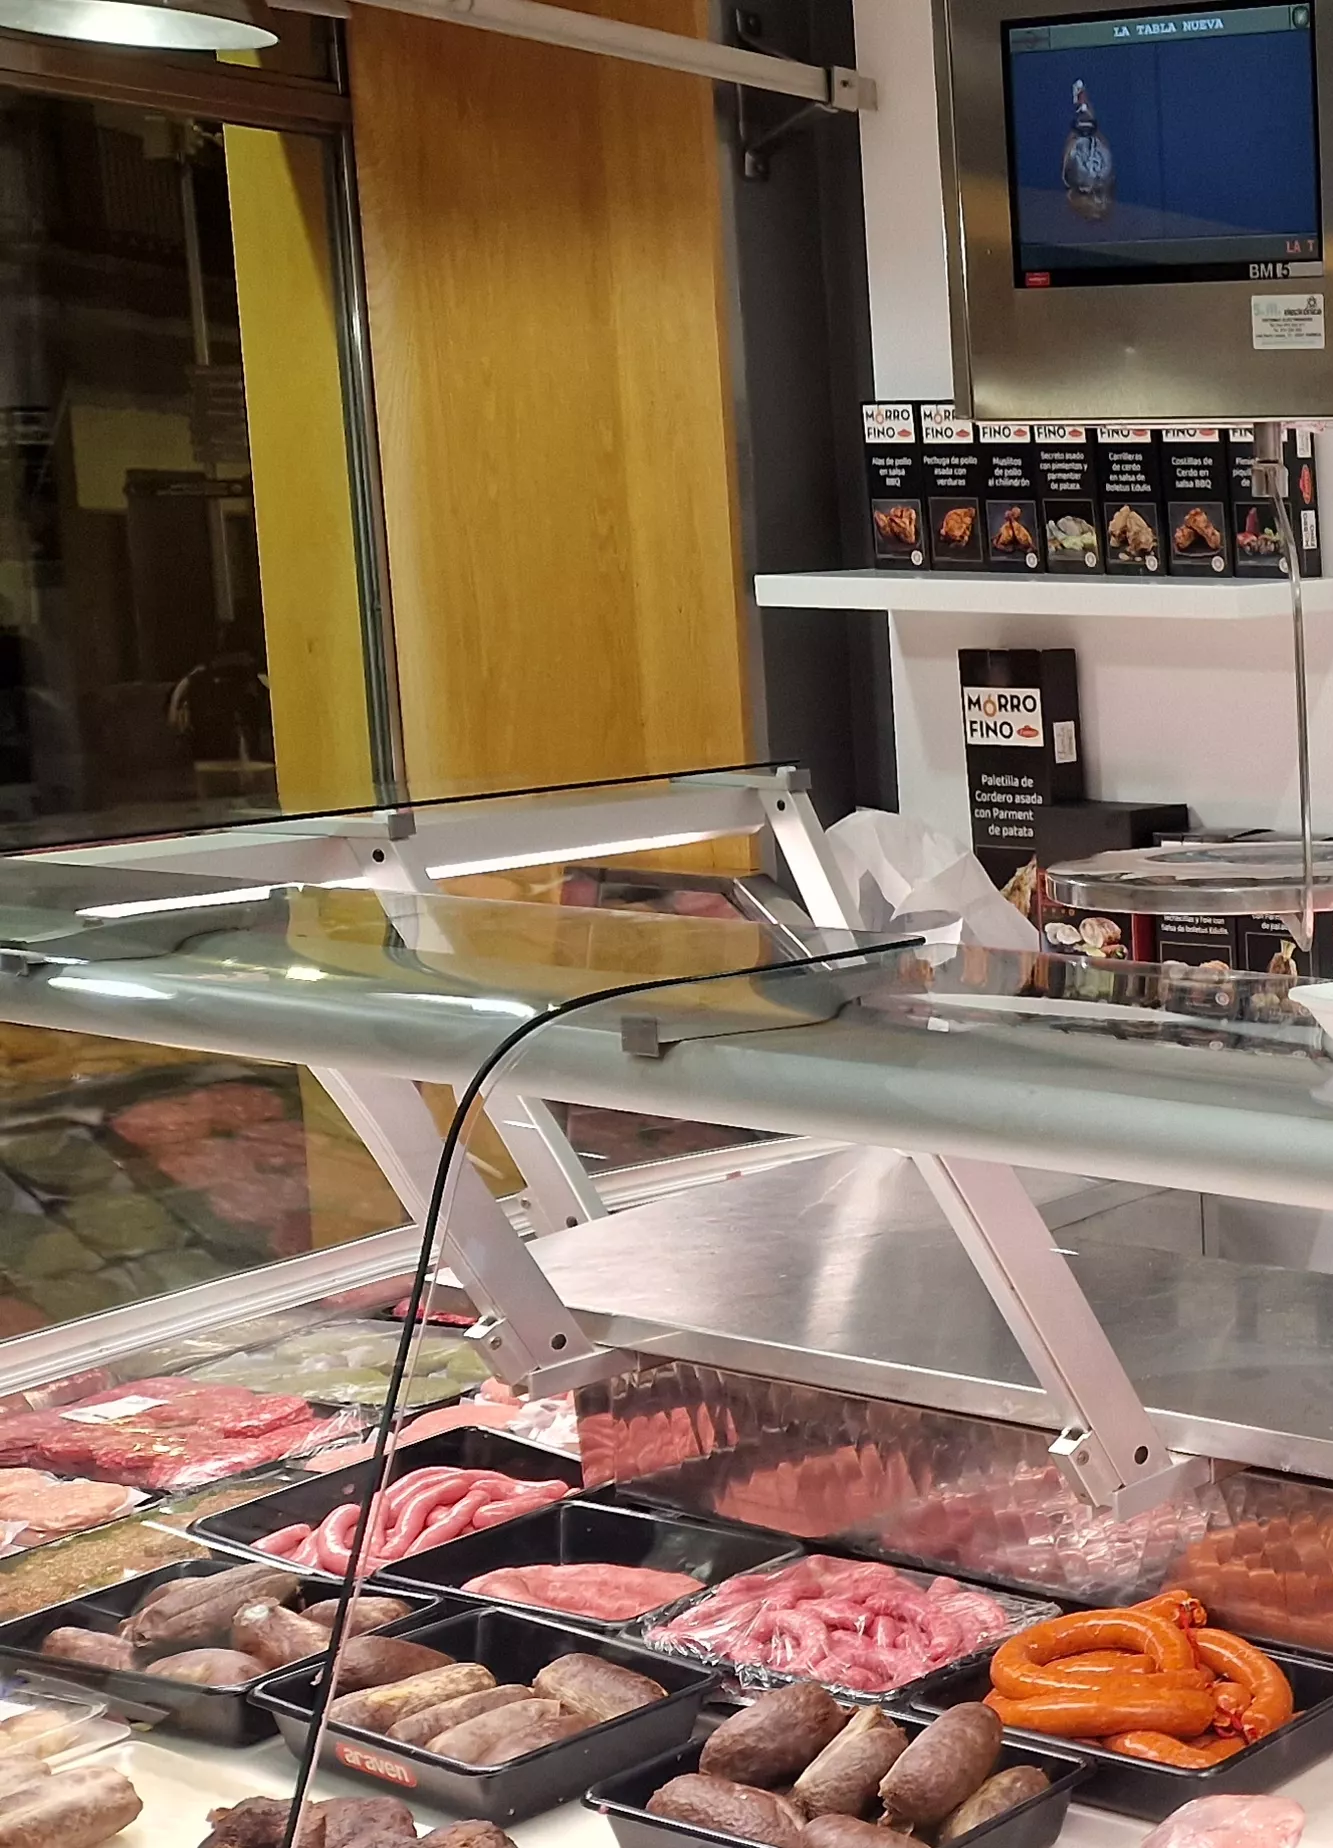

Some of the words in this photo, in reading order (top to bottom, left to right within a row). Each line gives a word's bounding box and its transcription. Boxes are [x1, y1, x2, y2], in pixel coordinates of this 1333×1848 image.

[1114, 26, 1129, 37] LA
[1136, 23, 1176, 35] TABLA
[1183, 18, 1224, 32] NUEVA
[1286, 240, 1301, 253] LA
[1307, 240, 1314, 252] T
[866, 408, 910, 425] MORRO
[923, 409, 956, 424] MOR
[867, 426, 895, 439] FINO
[925, 426, 954, 439] FINO
[982, 426, 1011, 439] FINO
[1037, 426, 1066, 439] FINO
[1232, 429, 1253, 438] FIN
[886, 456, 894, 466] de
[895, 456, 912, 467] pollo
[923, 456, 949, 467] Pechuga
[950, 456, 958, 465] de
[960, 456, 977, 466] pollo
[993, 457, 1022, 467] Muslitos
[1112, 463, 1120, 471] de
[1171, 457, 1202, 466] Costillas
[1203, 457, 1213, 466] de
[889, 467, 905, 476] salsa
[954, 468, 966, 476] con
[994, 468, 1004, 477] de
[1004, 468, 1022, 478] pollo
[1176, 469, 1198, 477] Cerdo
[1199, 469, 1209, 477] en
[936, 477, 966, 487] verduras
[1119, 473, 1136, 481] salsa
[1136, 474, 1145, 482] de
[1050, 482, 1058, 490] de
[1176, 479, 1194, 488] salsa
[967, 693, 1037, 717] MORRO
[969, 720, 1014, 739] FINO
[981, 774, 1019, 788] Paletilla
[1021, 775, 1034, 788] de
[975, 790, 1013, 804] Cordero
[1015, 793, 1043, 804] asada
[974, 808, 991, 818] con
[988, 824, 1000, 836] de
[1002, 825, 1034, 838] patata
[343, 1747, 410, 1783] araven
